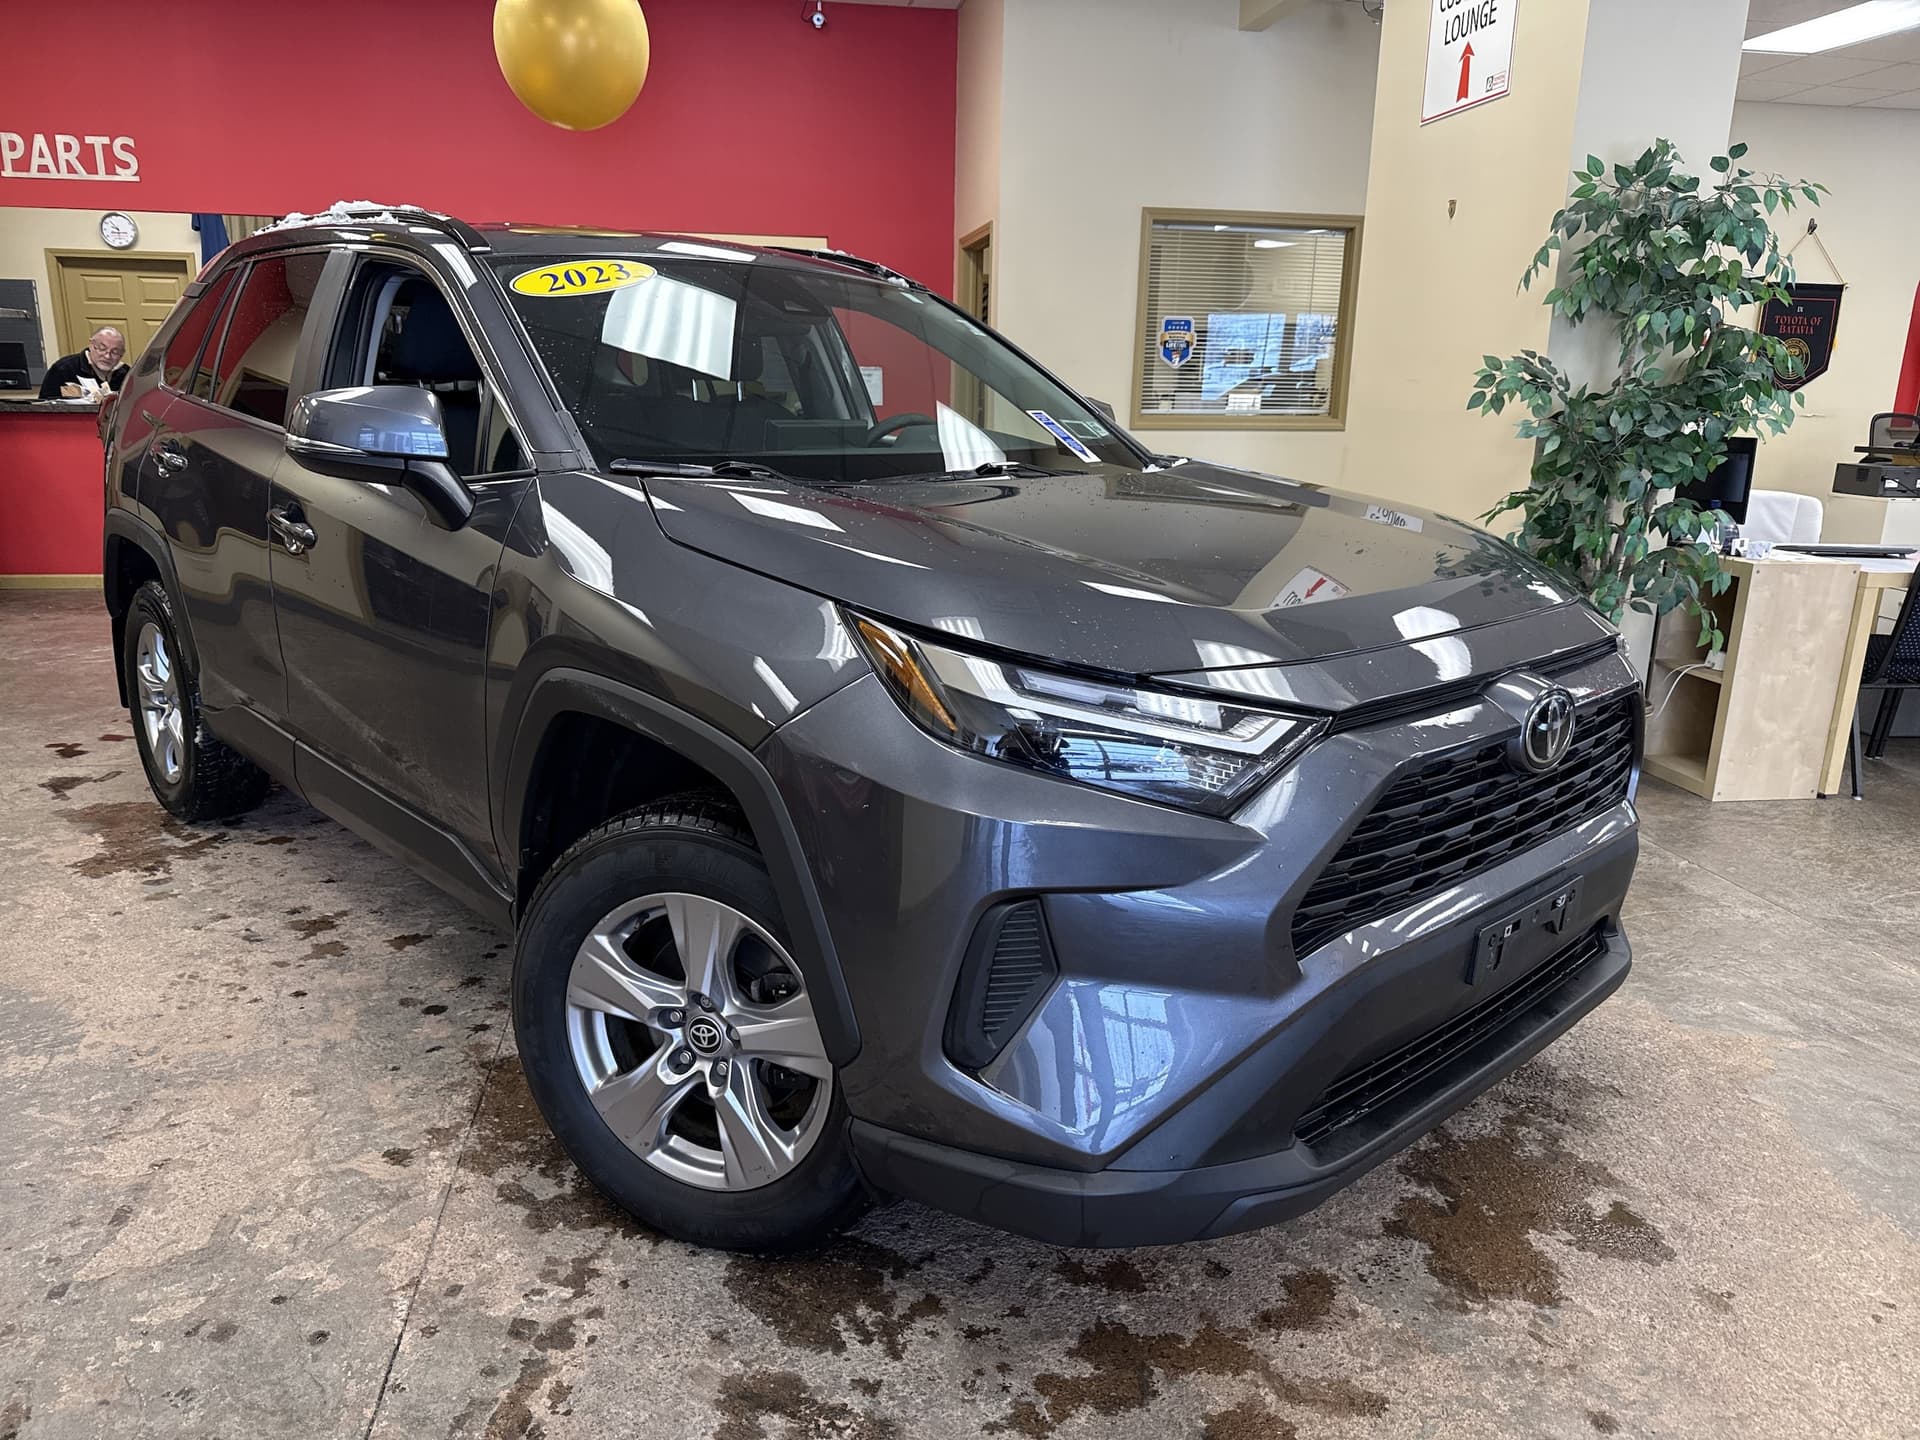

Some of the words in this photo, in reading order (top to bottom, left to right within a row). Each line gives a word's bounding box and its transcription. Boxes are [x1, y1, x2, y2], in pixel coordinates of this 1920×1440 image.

[1444, 0, 1498, 46] LOUNGE
[0, 131, 140, 180] PARTS
[539, 263, 632, 293] 2023
[1774, 315, 1808, 326] TOYOTA
[1810, 316, 1823, 326] OF
[1779, 325, 1814, 335] BATAVIA
